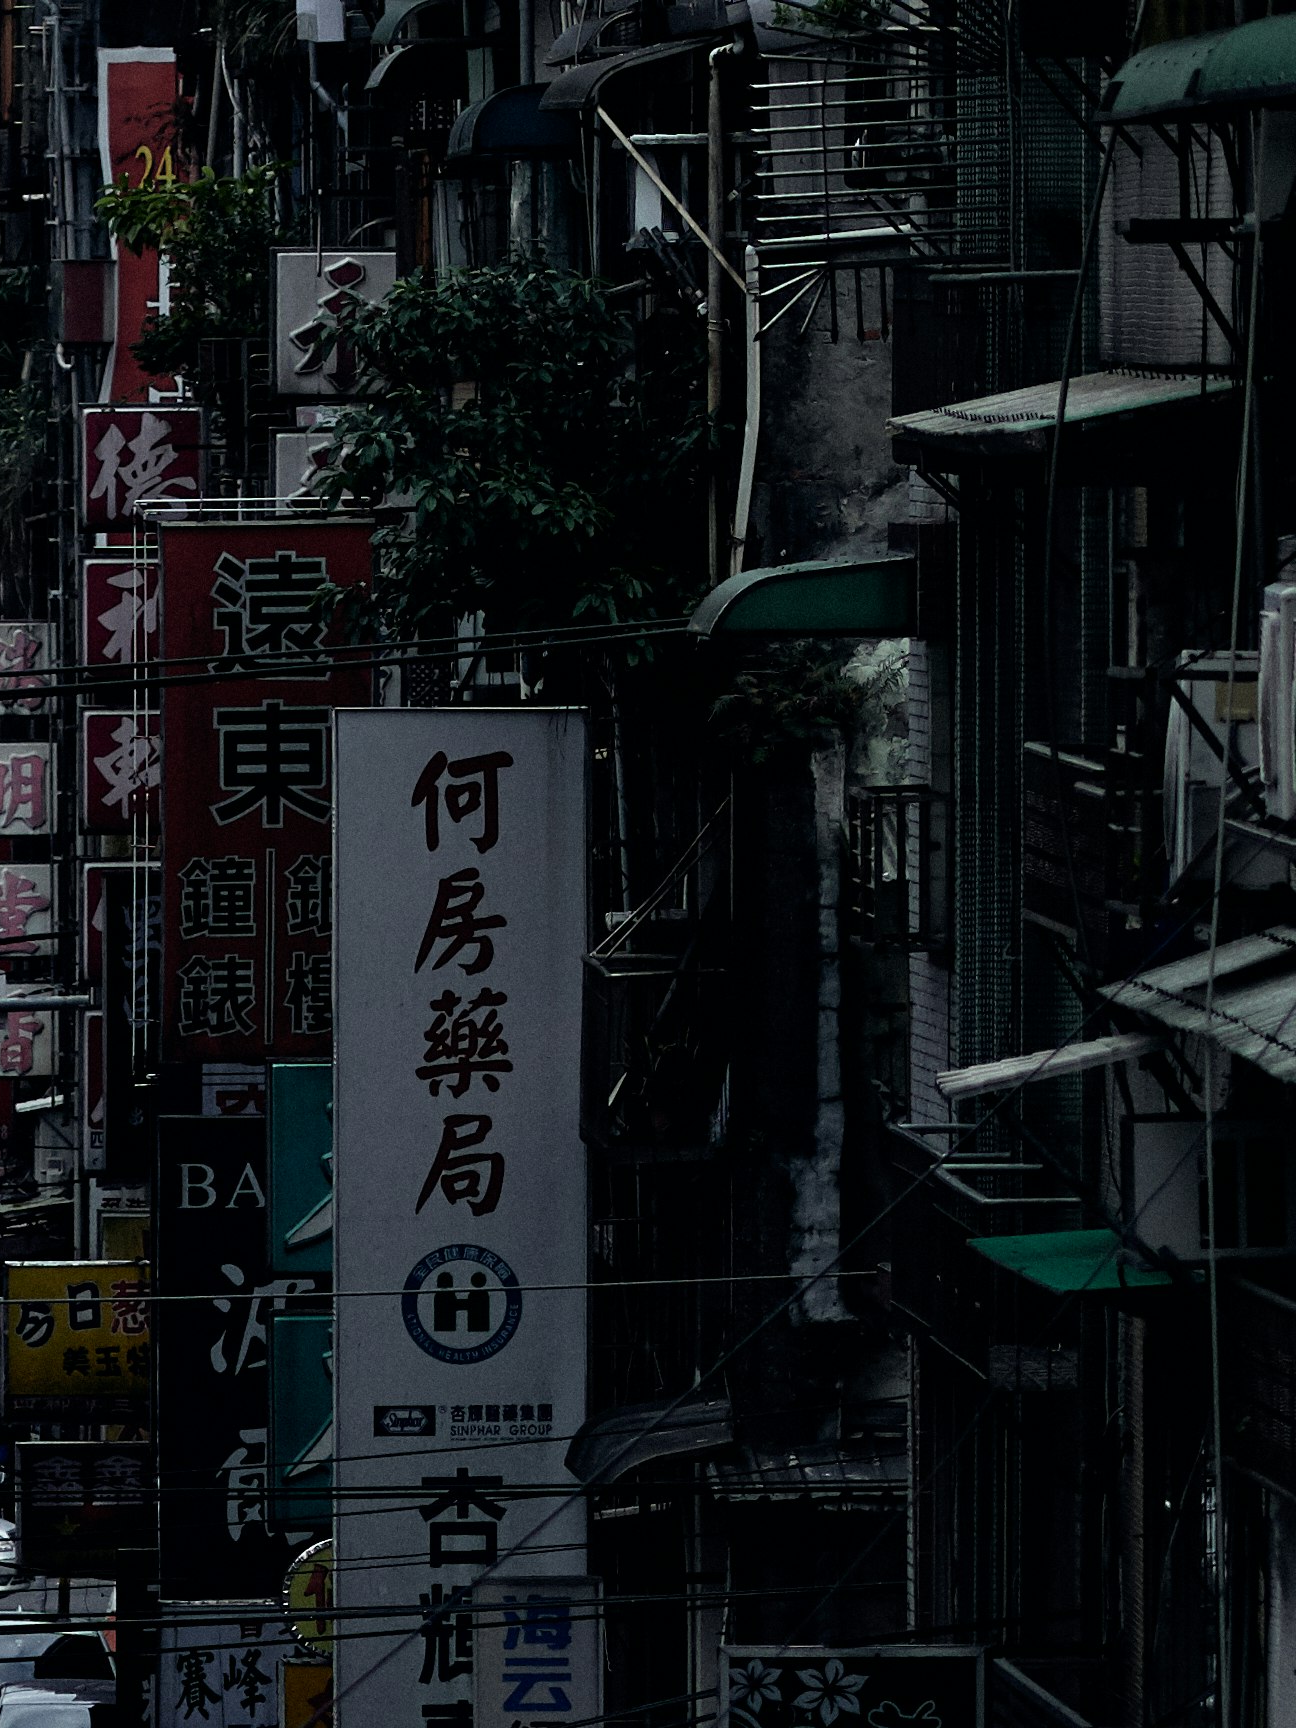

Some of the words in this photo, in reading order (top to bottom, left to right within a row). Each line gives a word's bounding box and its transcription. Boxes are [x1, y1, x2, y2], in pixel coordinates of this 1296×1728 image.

[208, 549, 334, 829] 遠東
[177, 854, 257, 1038] 鐘錶
[411, 750, 514, 1218] 何房藥局
[449, 1424, 501, 1436] SINPHAR
[509, 1424, 553, 1436] GROUP
